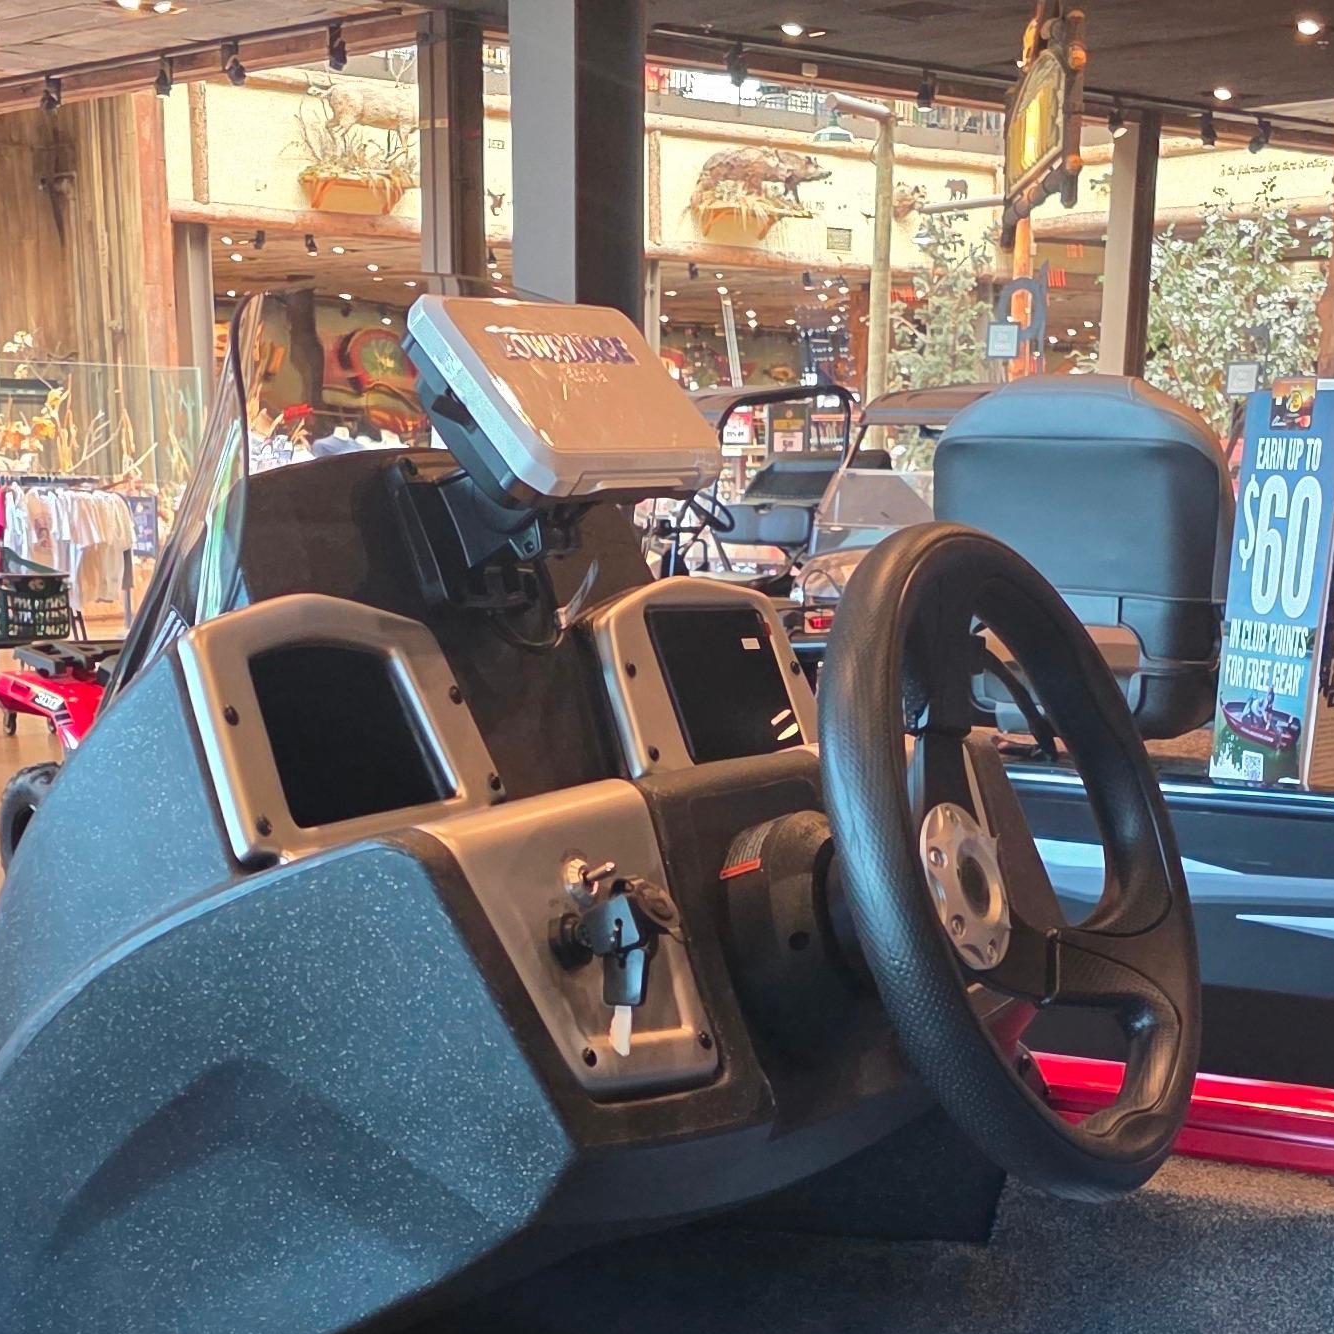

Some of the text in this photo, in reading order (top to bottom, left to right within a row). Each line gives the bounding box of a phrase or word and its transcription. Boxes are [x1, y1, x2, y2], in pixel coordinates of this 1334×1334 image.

[1255, 437, 1323, 472] EARN UP TO
[1238, 473, 1323, 619] $60
[1228, 618, 1310, 659] IN CLUB POINTS
[1224, 654, 1243, 687] FOR
[1243, 657, 1269, 691] FREE
